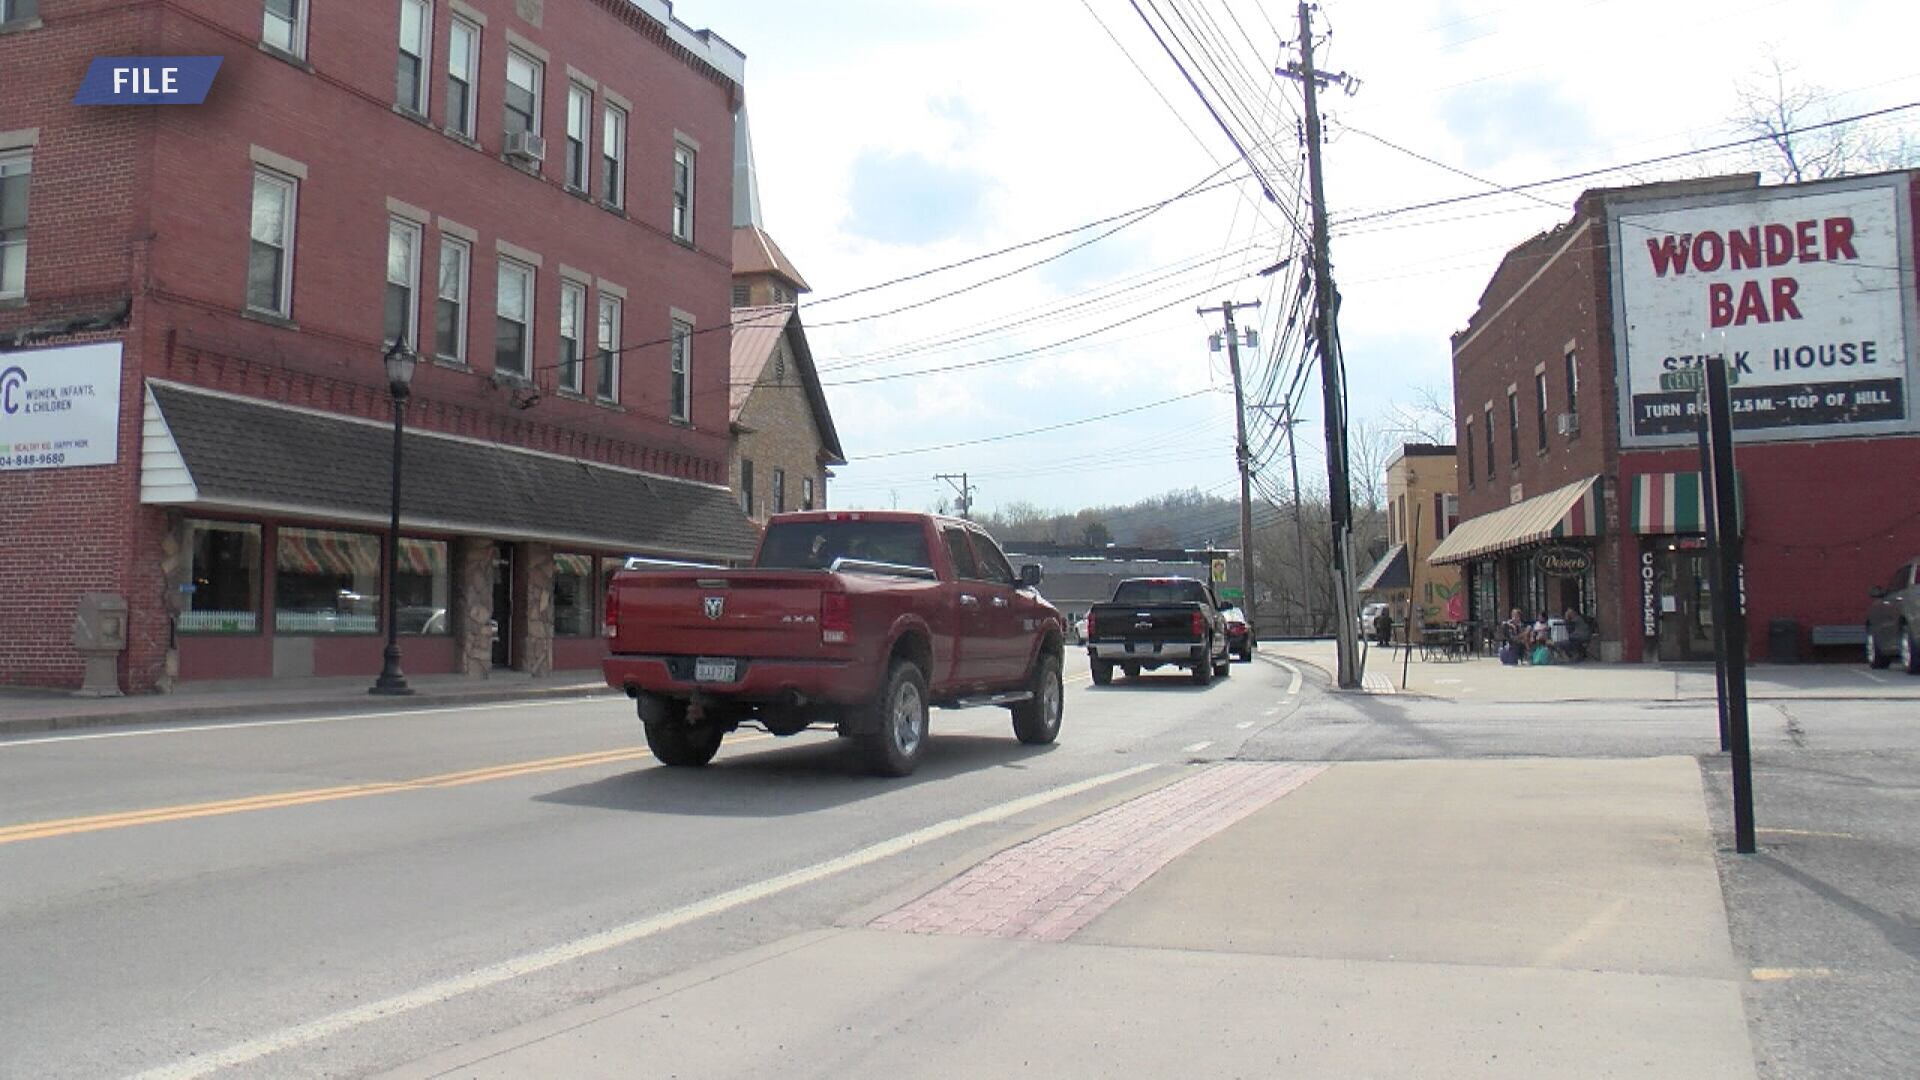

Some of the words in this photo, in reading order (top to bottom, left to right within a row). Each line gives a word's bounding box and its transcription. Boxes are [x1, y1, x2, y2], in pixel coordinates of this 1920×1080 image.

[1647, 217, 1858, 278] WONDER
[1710, 277, 1802, 328] BAR
[1663, 351, 1752, 374] STK
[1773, 341, 1877, 371] HOUSE
[25, 403, 31, 413] &
[33, 399, 72, 412] CHILDREN
[26, 388, 58, 400] WOMEN,
[60, 384, 96, 398] INFANTS,
[1644, 402, 1680, 418] TURN
[1788, 395, 1819, 409] TOP
[1826, 393, 1846, 406] OF
[1855, 390, 1891, 404] HILL
[14, 443, 40, 452] HEALTHY
[54, 440, 73, 449] HAPPY
[1642, 552, 1655, 637] COFFEE
